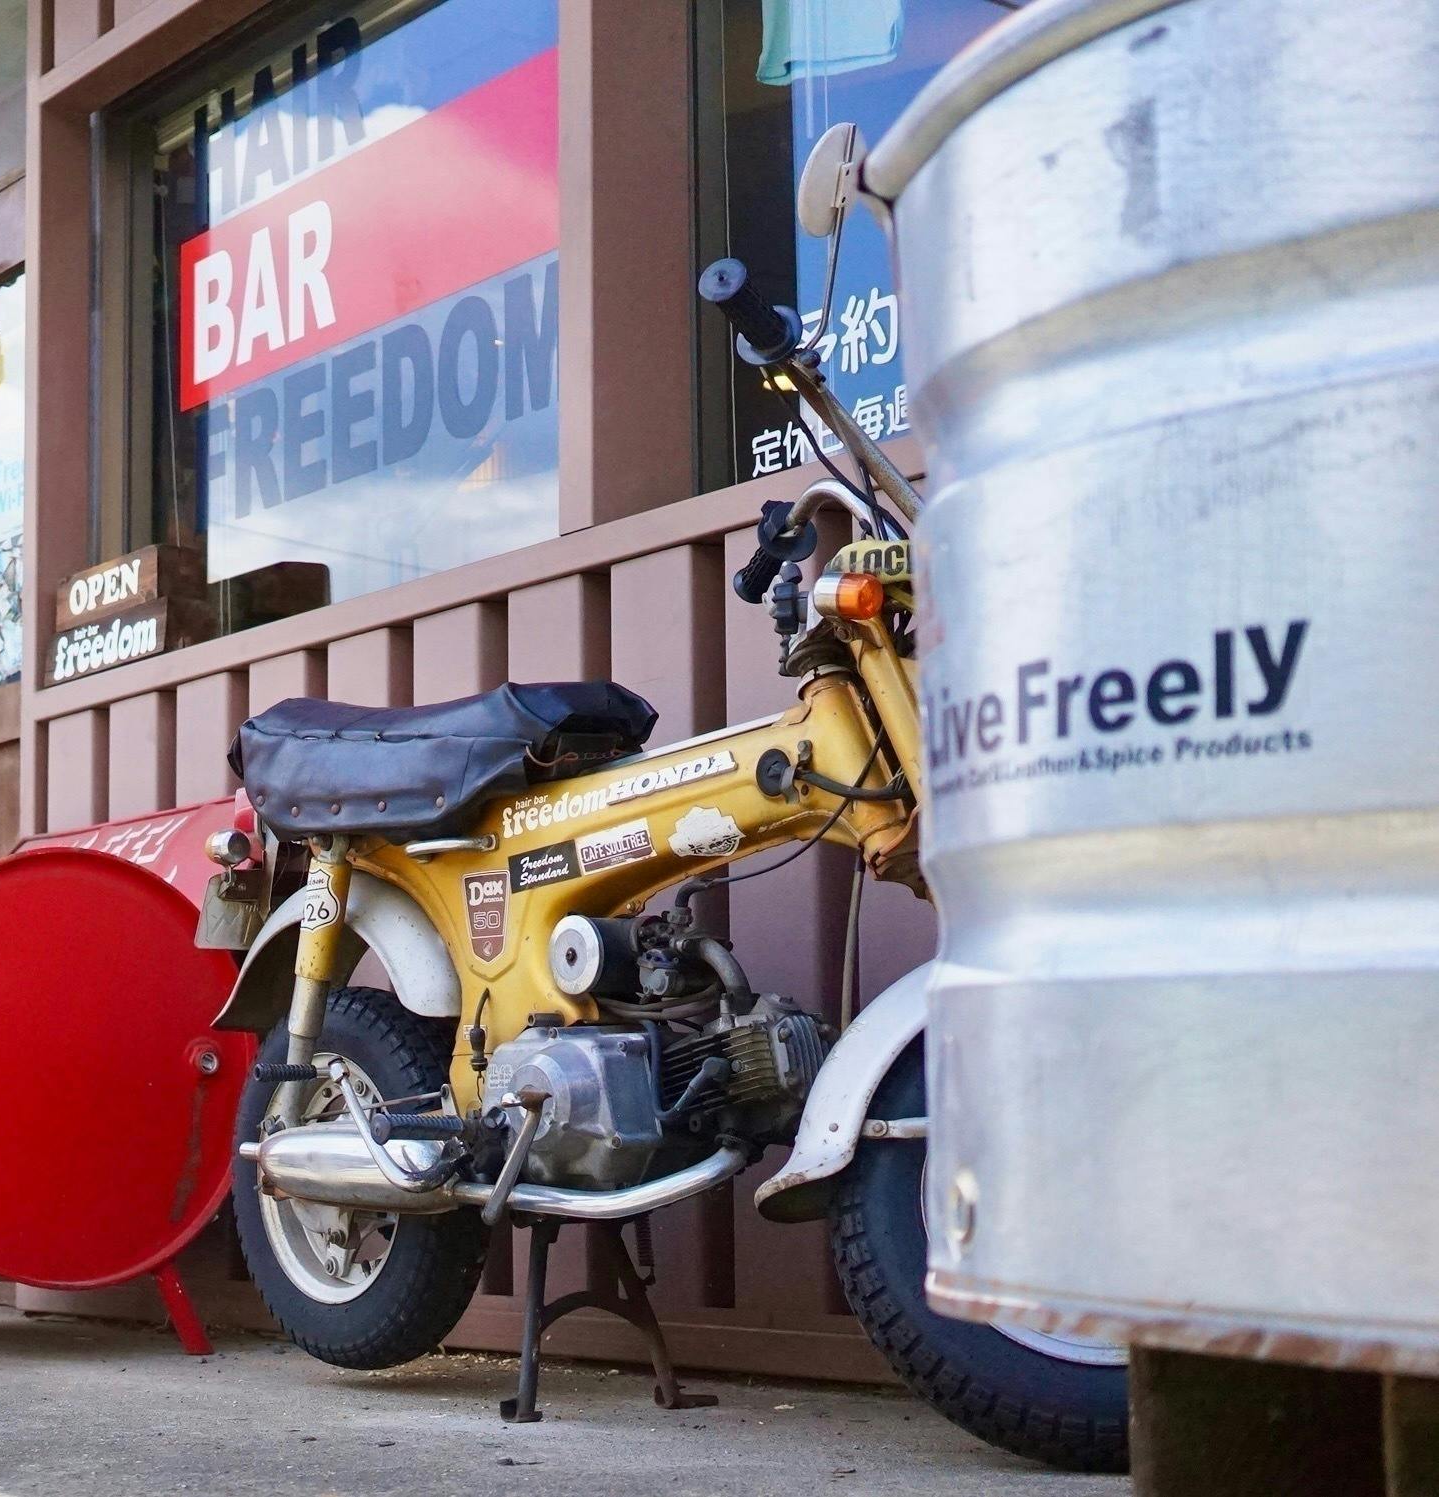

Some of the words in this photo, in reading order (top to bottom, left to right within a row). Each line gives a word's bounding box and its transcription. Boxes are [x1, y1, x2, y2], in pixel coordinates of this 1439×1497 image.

[194, 17, 367, 226] HAIR
[193, 200, 336, 386] BAR
[196, 260, 559, 532] FREEDOM
[848, 544, 912, 575] LOC
[69, 559, 141, 616] OPEN
[53, 618, 157, 681] freedom
[1175, 729, 1313, 761] Products
[609, 750, 737, 806] HONDA
[502, 787, 610, 839] freedom
[514, 797, 531, 810] hair
[533, 793, 549, 806] bar
[519, 853, 564, 873] Freedom
[519, 864, 570, 886] Standard
[469, 880, 504, 906] Dax
[473, 910, 501, 929] 50
